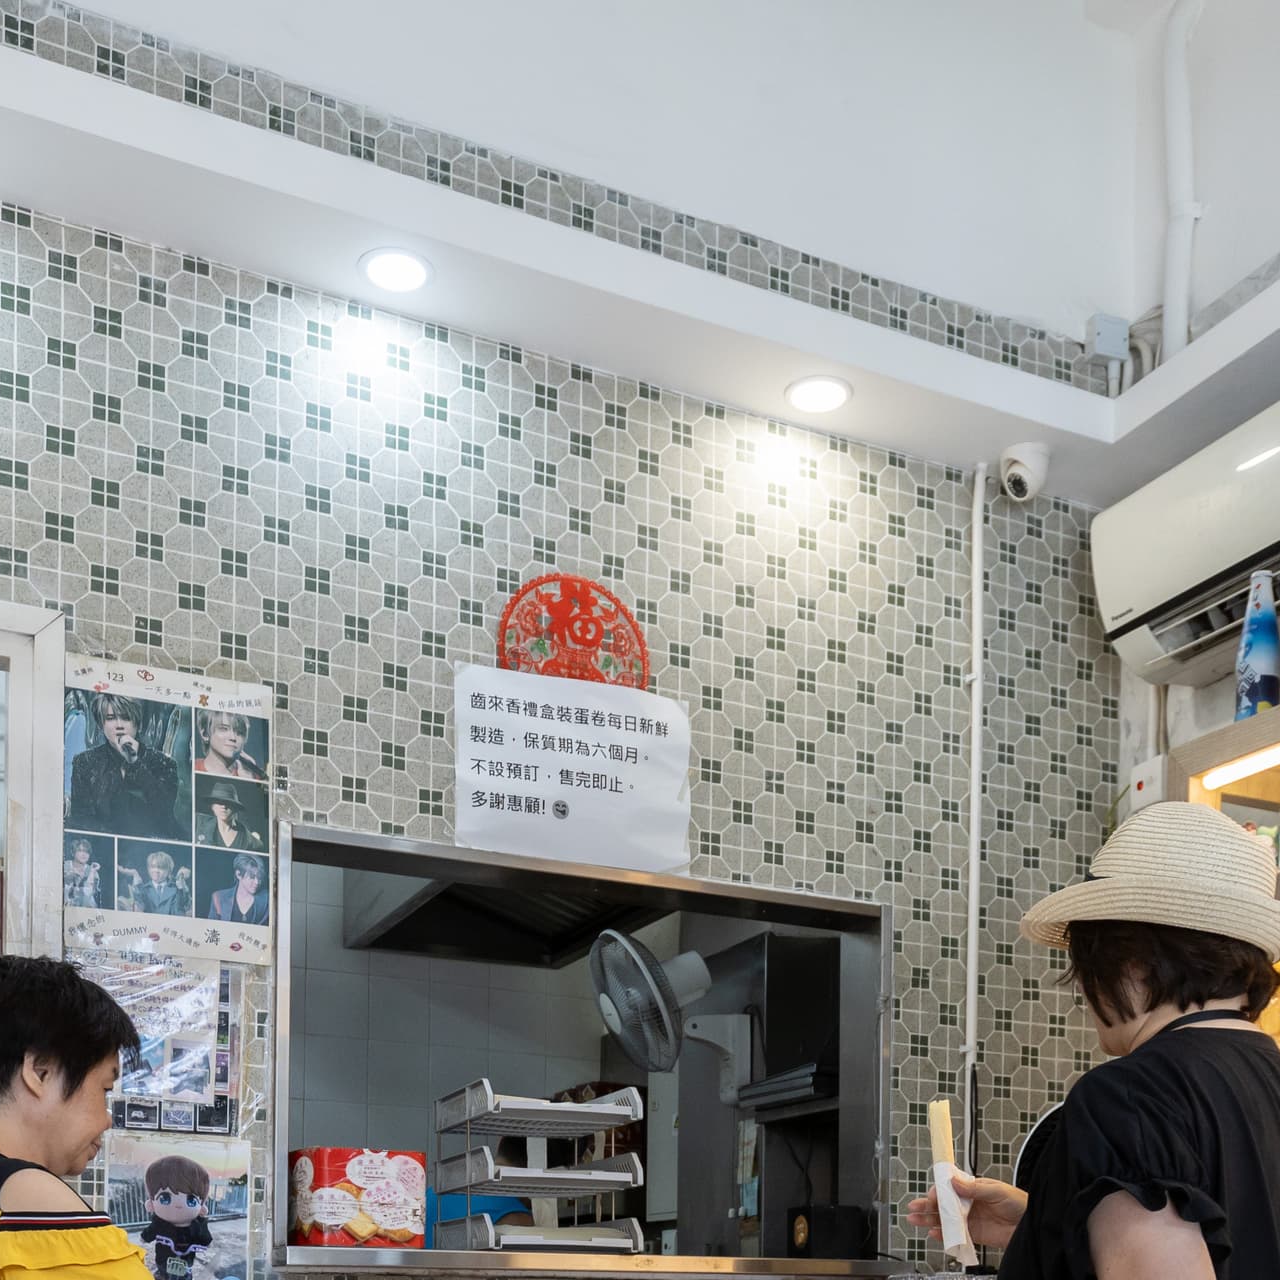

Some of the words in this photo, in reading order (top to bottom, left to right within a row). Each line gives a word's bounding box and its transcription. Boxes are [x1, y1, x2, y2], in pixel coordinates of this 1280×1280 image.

[107, 671, 124, 682] 123
[470, 691, 669, 738] 齒來香禮盒裝蛋卷每日新鮮
[112, 926, 149, 937] DUMMY
